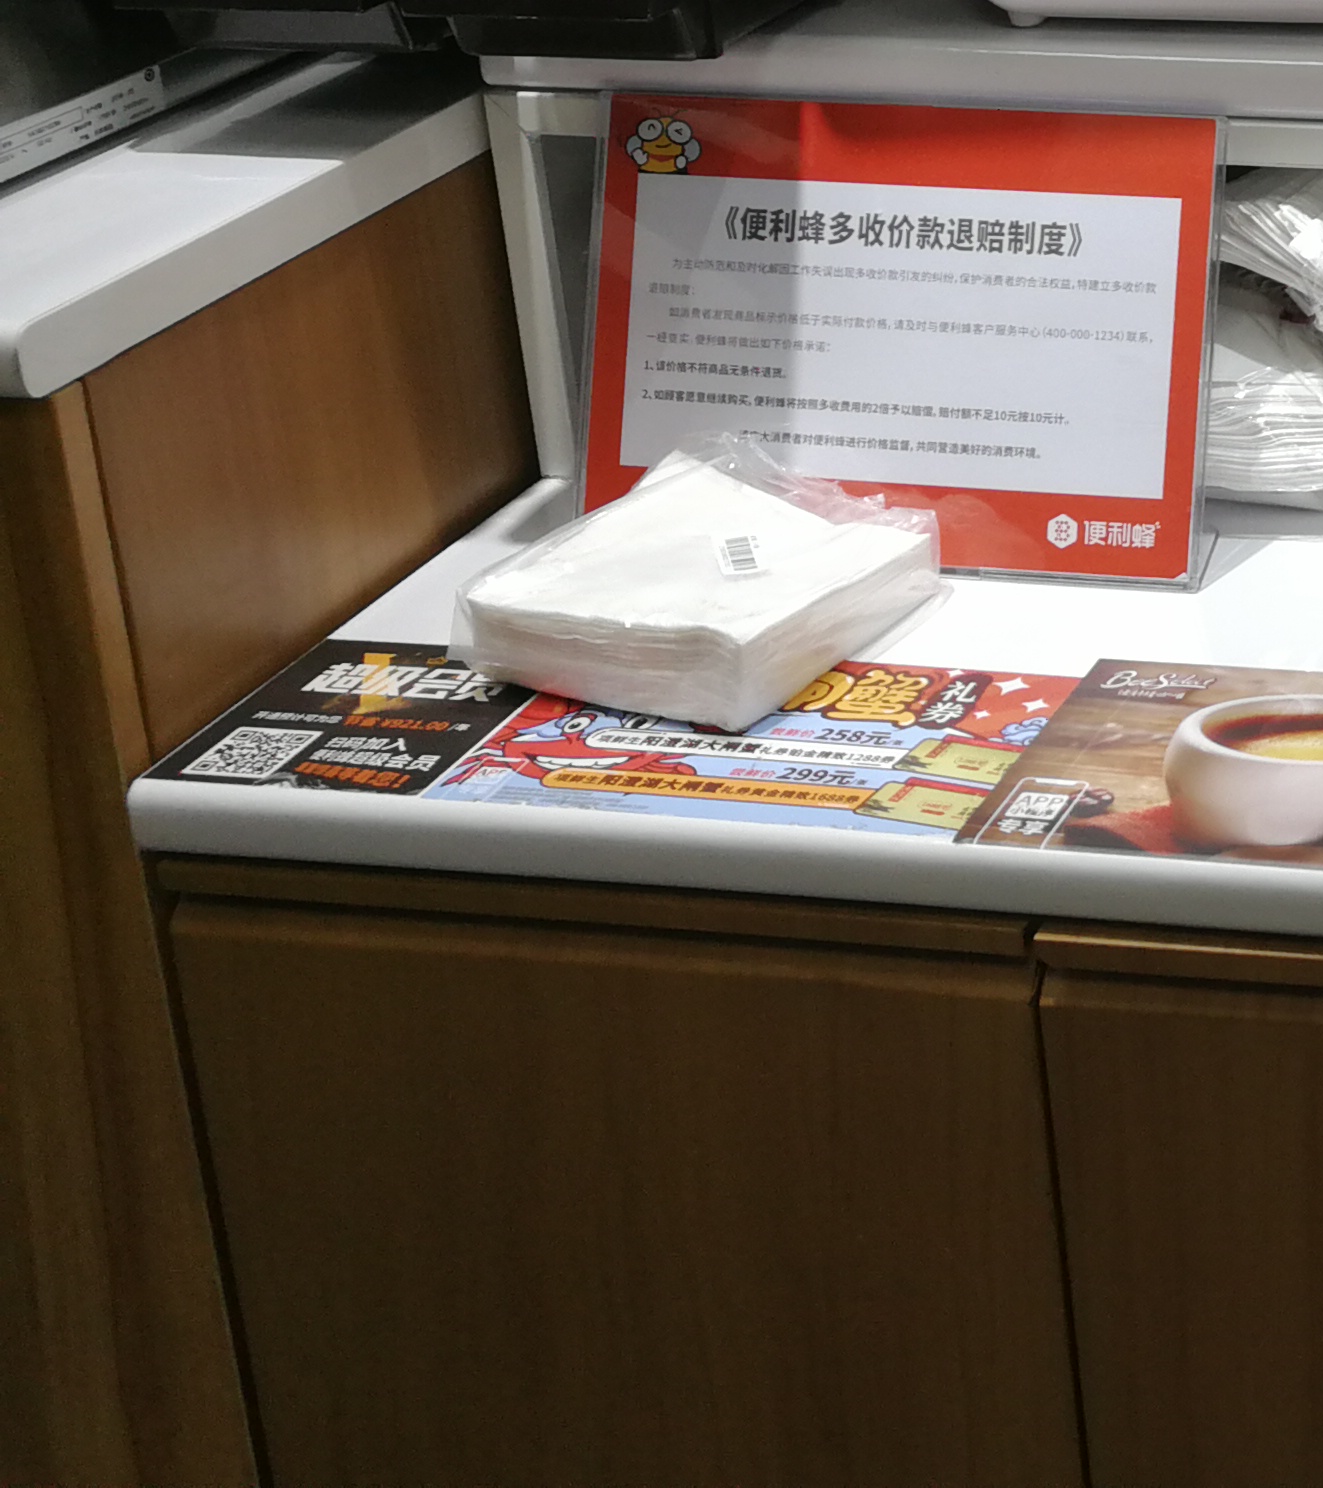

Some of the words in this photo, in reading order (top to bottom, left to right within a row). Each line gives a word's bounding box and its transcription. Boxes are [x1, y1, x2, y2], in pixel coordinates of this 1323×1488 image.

[724, 206, 1084, 257] 《便利蜂多收价款退赔制度》
[1083, 519, 1161, 549] 便利蜂
[301, 662, 505, 702] 超级会员
[918, 680, 978, 724] 礼券
[325, 737, 407, 753] 扫码加入
[1014, 794, 1064, 807] APP
[998, 818, 1049, 836] 专享
